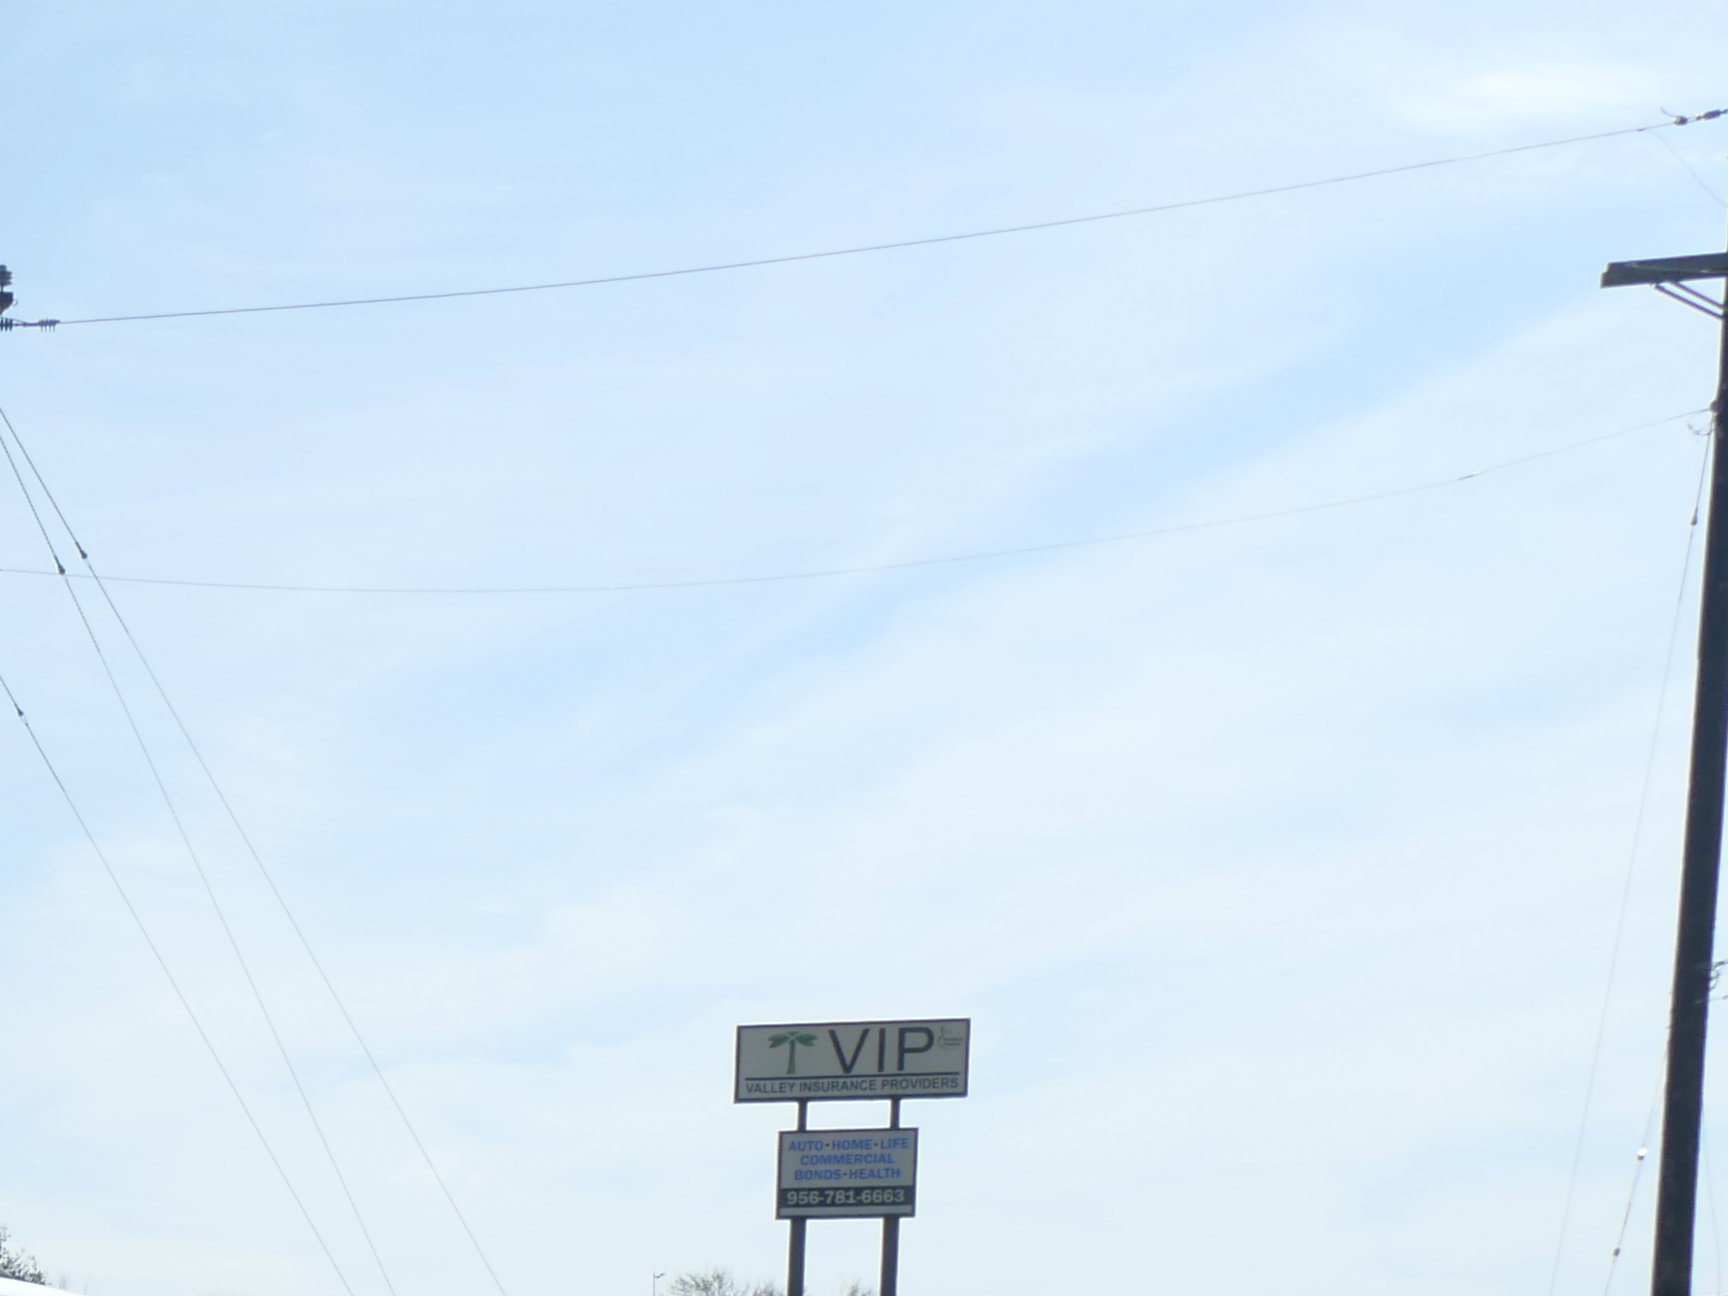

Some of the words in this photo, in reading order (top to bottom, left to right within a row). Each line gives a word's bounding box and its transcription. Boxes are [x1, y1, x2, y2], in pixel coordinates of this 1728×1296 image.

[828, 1026, 935, 1075] VIP
[745, 1081, 795, 1094] VALLEY
[799, 1079, 877, 1093] INSURANCE
[881, 1076, 959, 1091] PROVIDERS
[788, 1140, 824, 1152] AUTO
[831, 1138, 873, 1151] HOME
[880, 1137, 910, 1150] LIFE
[800, 1153, 895, 1166] COMMERCIAL
[794, 1169, 842, 1181] BONDS
[848, 1167, 901, 1180] HEALTH
[786, 1188, 905, 1206] 956-781-6663
